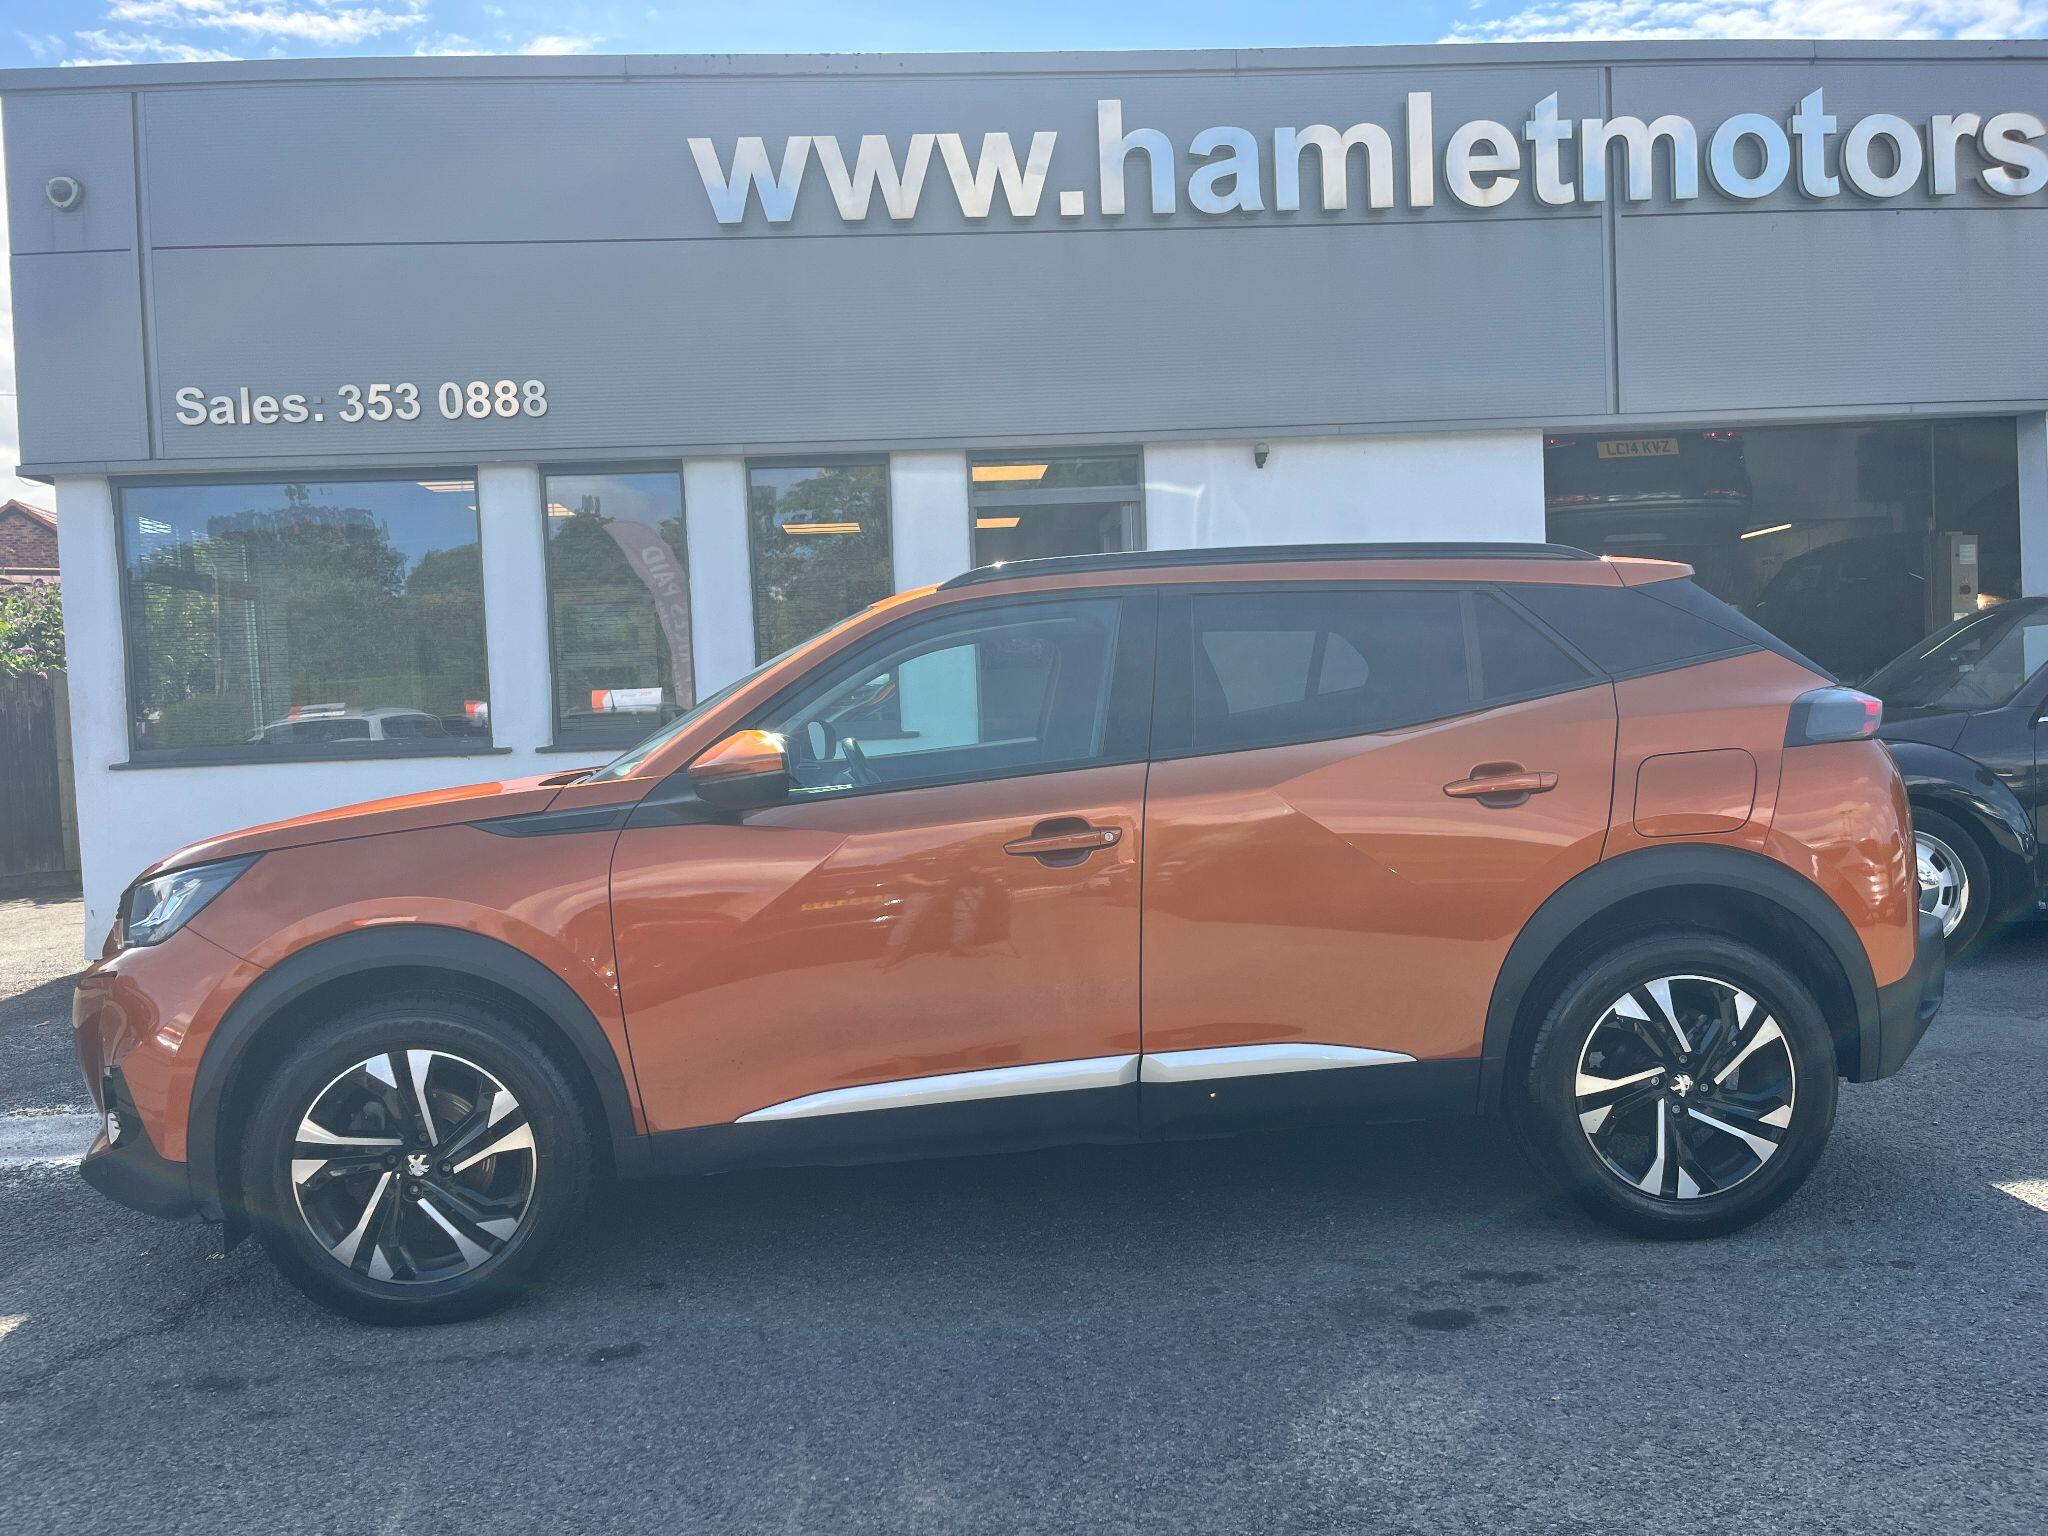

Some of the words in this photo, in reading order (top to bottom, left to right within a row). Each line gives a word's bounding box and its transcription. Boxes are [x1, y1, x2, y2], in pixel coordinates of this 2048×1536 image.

[687, 87, 2048, 223] www.hamletmotors
[175, 387, 325, 426] Sales:
[338, 383, 422, 423] 353
[438, 379, 549, 420] 0888
